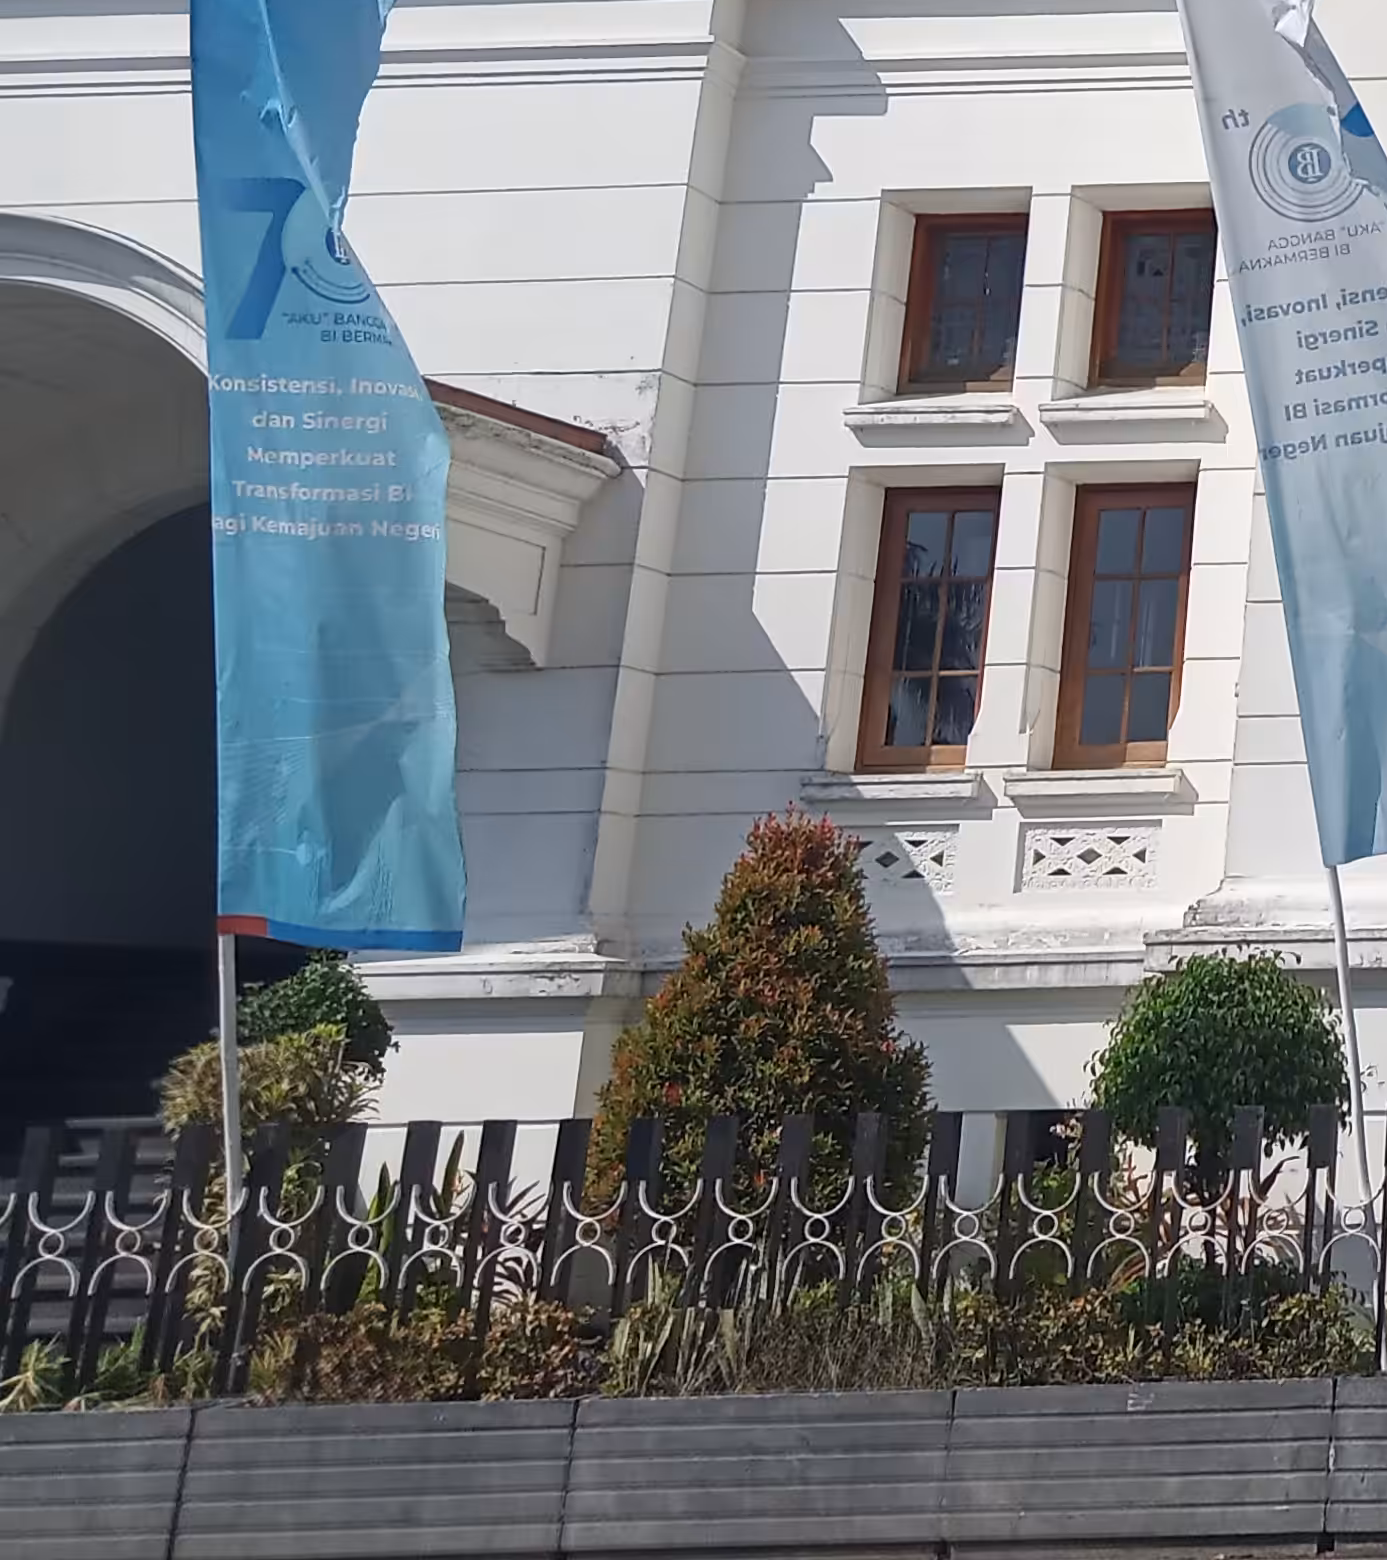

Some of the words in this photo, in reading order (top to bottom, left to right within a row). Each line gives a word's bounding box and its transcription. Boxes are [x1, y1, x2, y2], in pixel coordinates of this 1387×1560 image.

[320, 329, 337, 342] BI
[208, 374, 342, 396] Konsistensi,
[252, 410, 295, 430] dan
[302, 411, 388, 434] Sinergi
[247, 446, 397, 469] Memperkuat
[232, 480, 380, 501] Transformasi
[388, 485, 412, 503] BI
[213, 513, 246, 535] agi
[252, 516, 363, 540] Kemajuan
